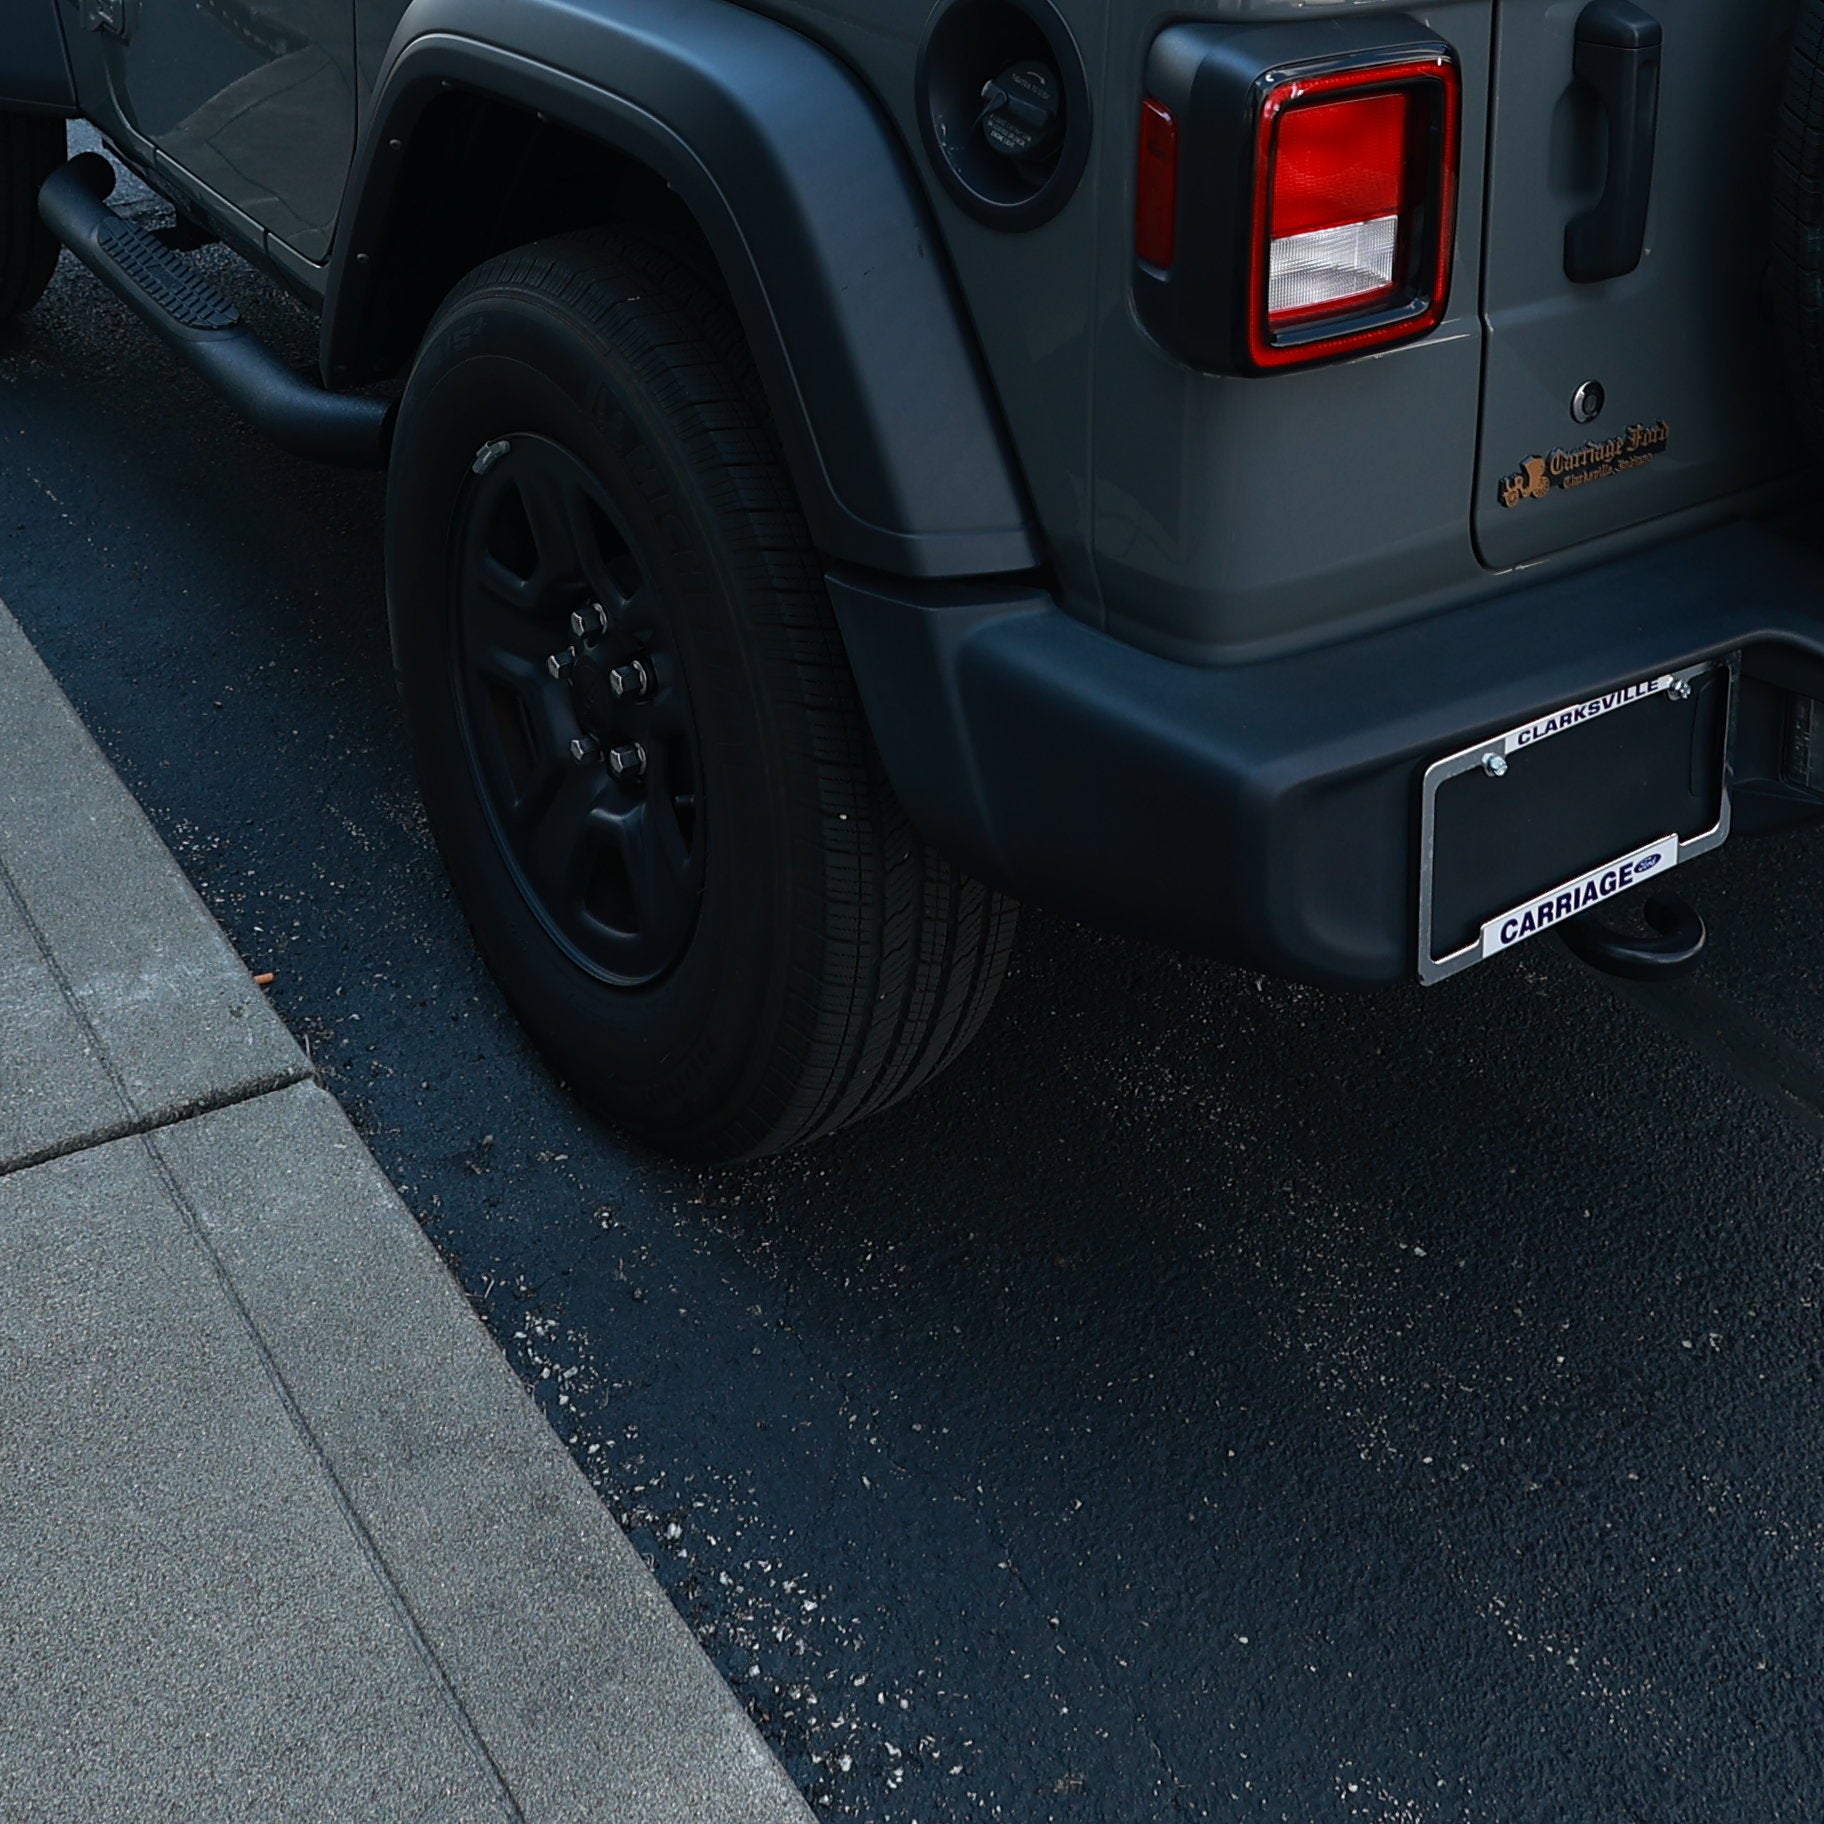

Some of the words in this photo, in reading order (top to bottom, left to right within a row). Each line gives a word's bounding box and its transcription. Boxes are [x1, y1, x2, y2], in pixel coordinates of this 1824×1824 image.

[1550, 439, 1625, 475] Carriage
[1627, 420, 1670, 451] Ford
[1517, 678, 1659, 746] CLARKSVILLE
[1500, 862, 1634, 944] CARRIAGE
